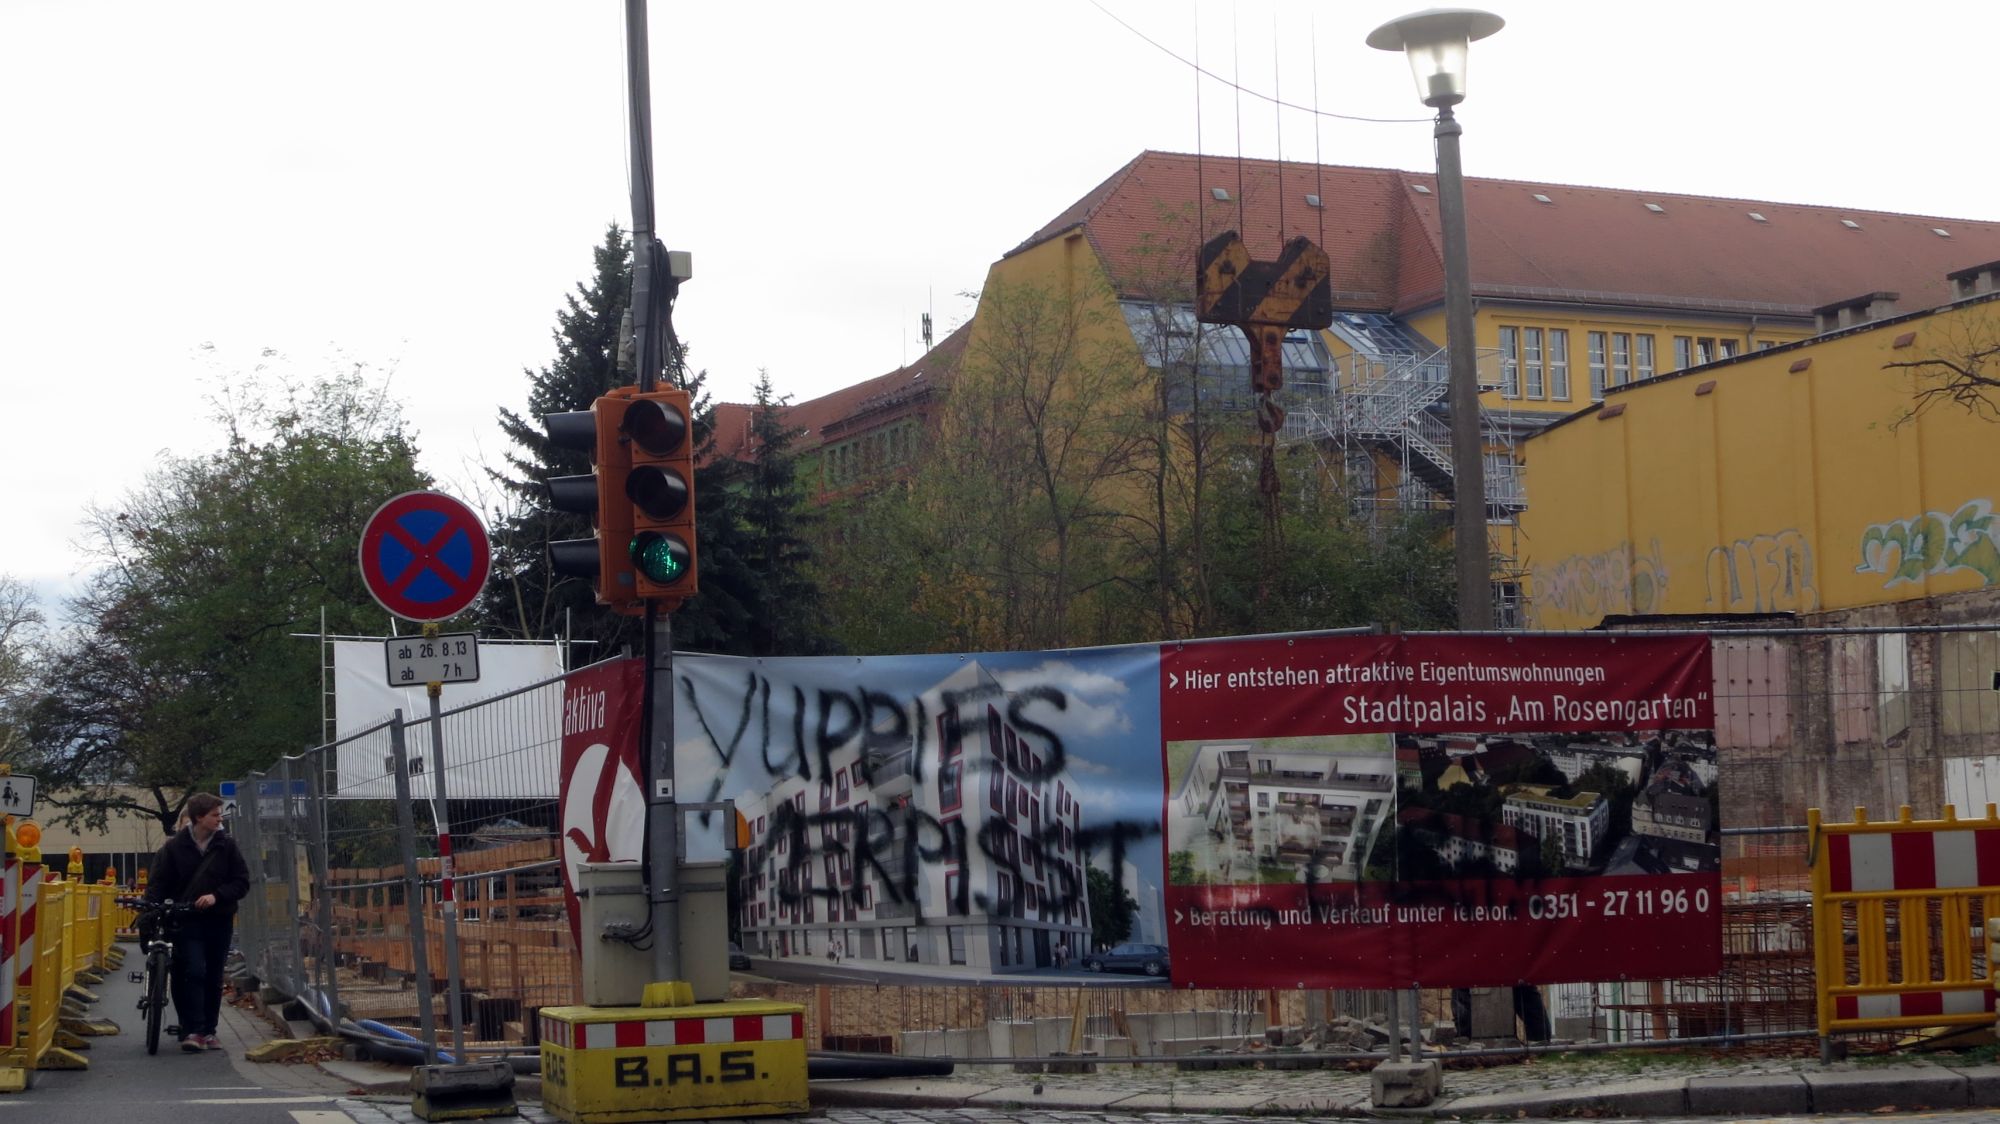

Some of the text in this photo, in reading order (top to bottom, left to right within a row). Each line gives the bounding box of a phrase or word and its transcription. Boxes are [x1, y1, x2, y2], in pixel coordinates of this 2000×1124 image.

[398, 645, 412, 659] ab
[401, 663, 462, 681] ab 7 h
[1185, 661, 1605, 690] Hier entstehen attraktive Eigentumswohnungen
[565, 687, 605, 736] aktiva
[1343, 694, 1486, 728] Stadtpalais
[681, 670, 1067, 828] YUPPIES
[1190, 907, 1272, 929] Beratung
[1279, 904, 1312, 925] und
[1319, 903, 1391, 924] Verkauf
[1398, 904, 1445, 923] unter
[1528, 893, 1578, 920] 0351
[1603, 891, 1629, 916] 27
[1635, 890, 1653, 915] 11
[1660, 889, 1689, 914] 96
[1695, 888, 1709, 913] 0
[615, 1050, 769, 1088] B.A.S.
